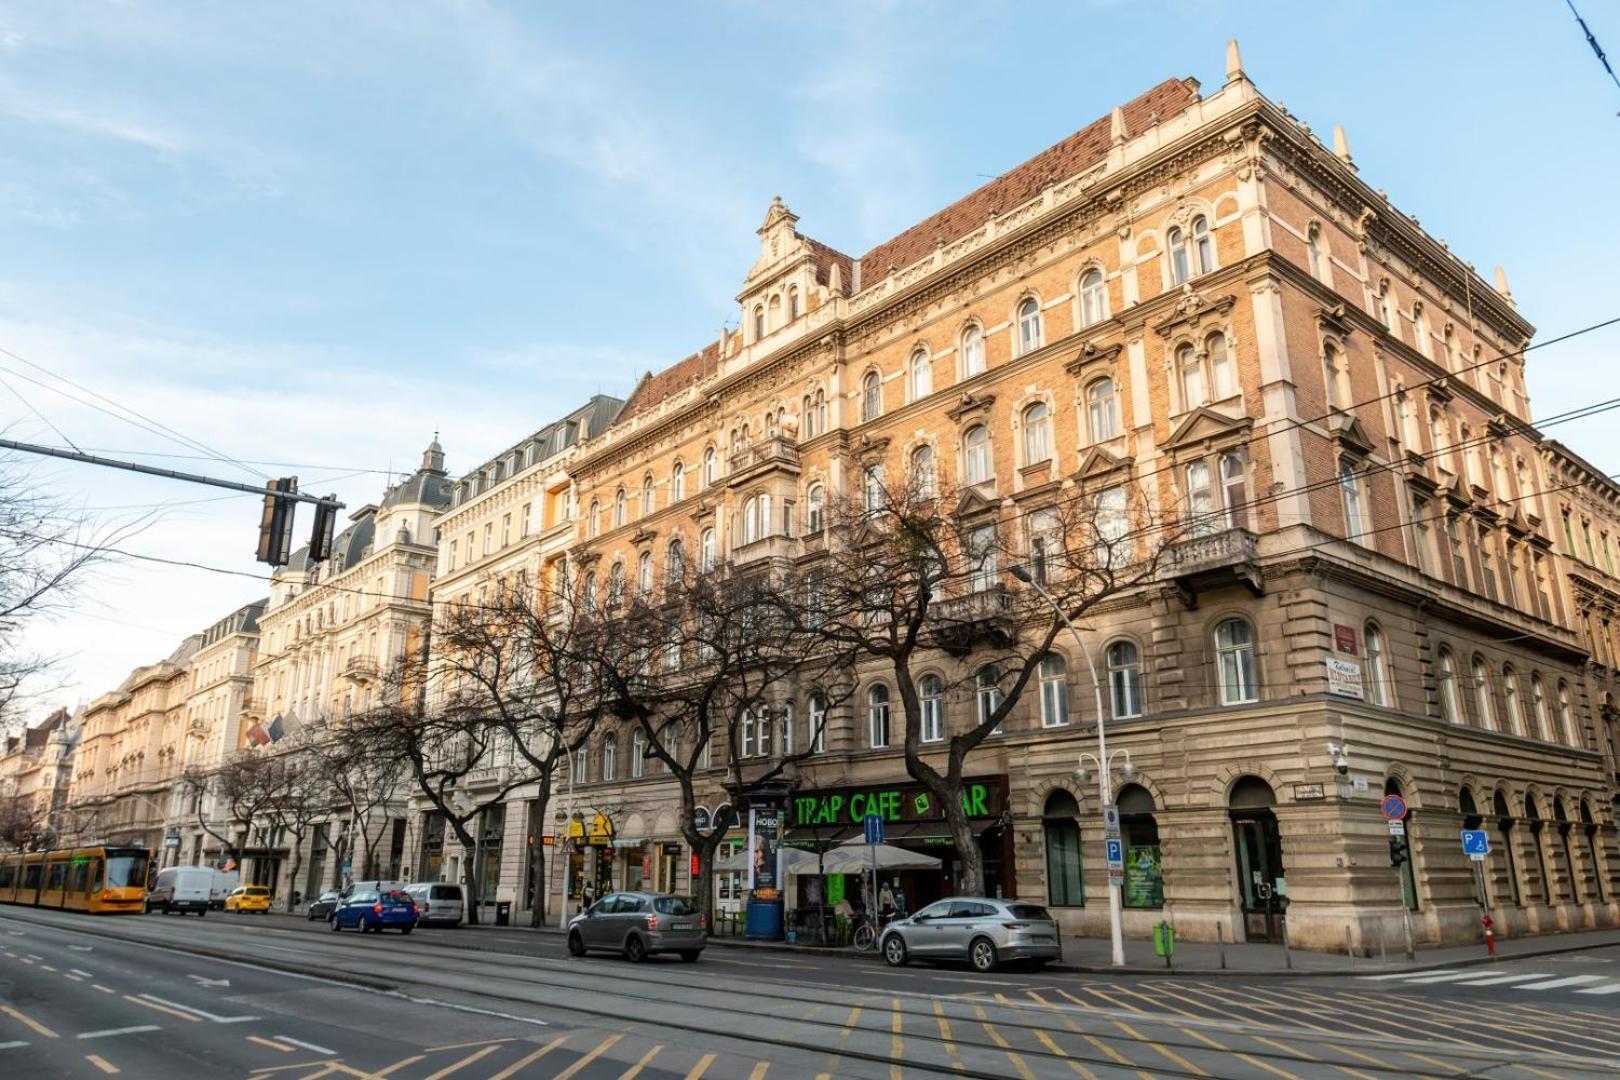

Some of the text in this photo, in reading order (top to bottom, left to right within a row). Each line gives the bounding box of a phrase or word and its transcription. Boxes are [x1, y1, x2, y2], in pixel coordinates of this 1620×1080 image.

[795, 784, 988, 824] TRAP CAFE AR
[1465, 834, 1473, 844] P
[1110, 842, 1118, 859] P
